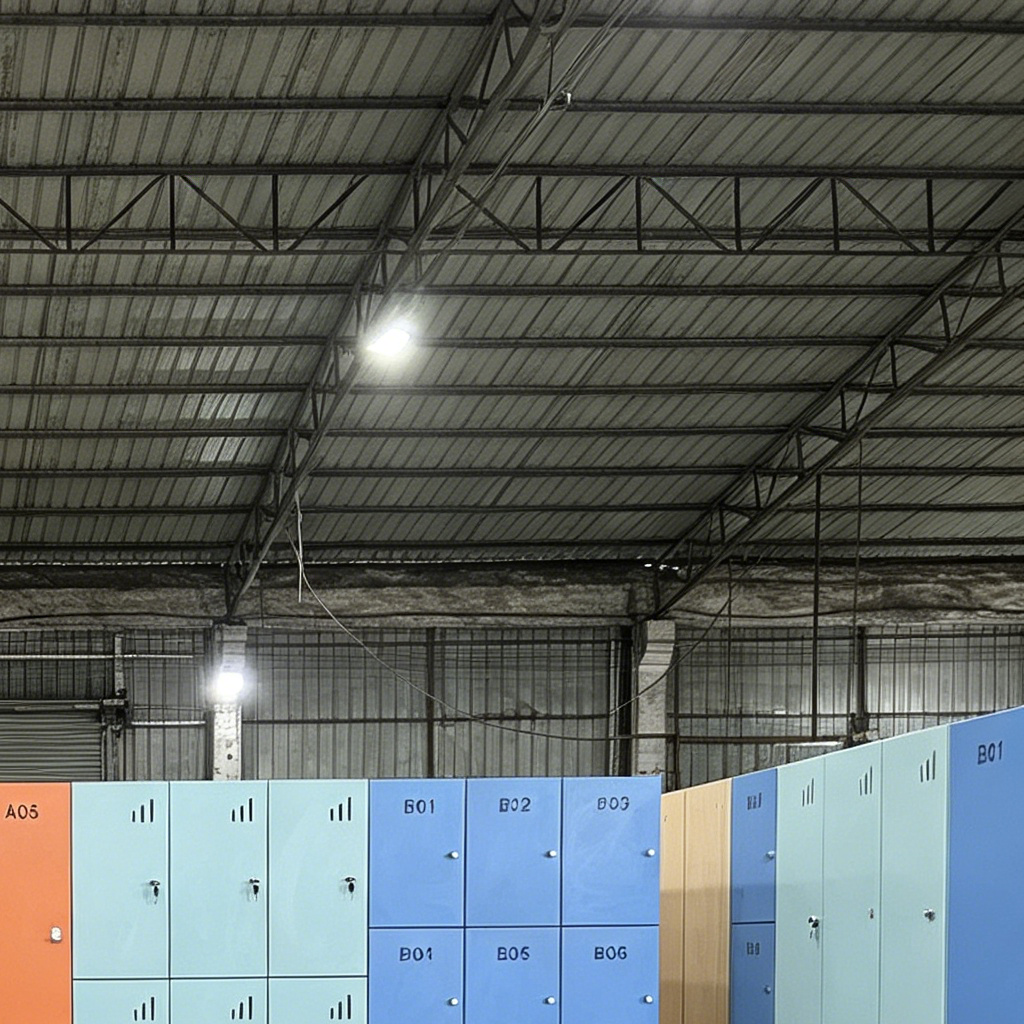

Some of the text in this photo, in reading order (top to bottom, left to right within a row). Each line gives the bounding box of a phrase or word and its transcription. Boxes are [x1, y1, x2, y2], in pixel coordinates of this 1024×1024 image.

[977, 740, 1004, 765] B01
[404, 799, 435, 814] B01
[499, 798, 531, 812] B02
[594, 945, 627, 960] B06
